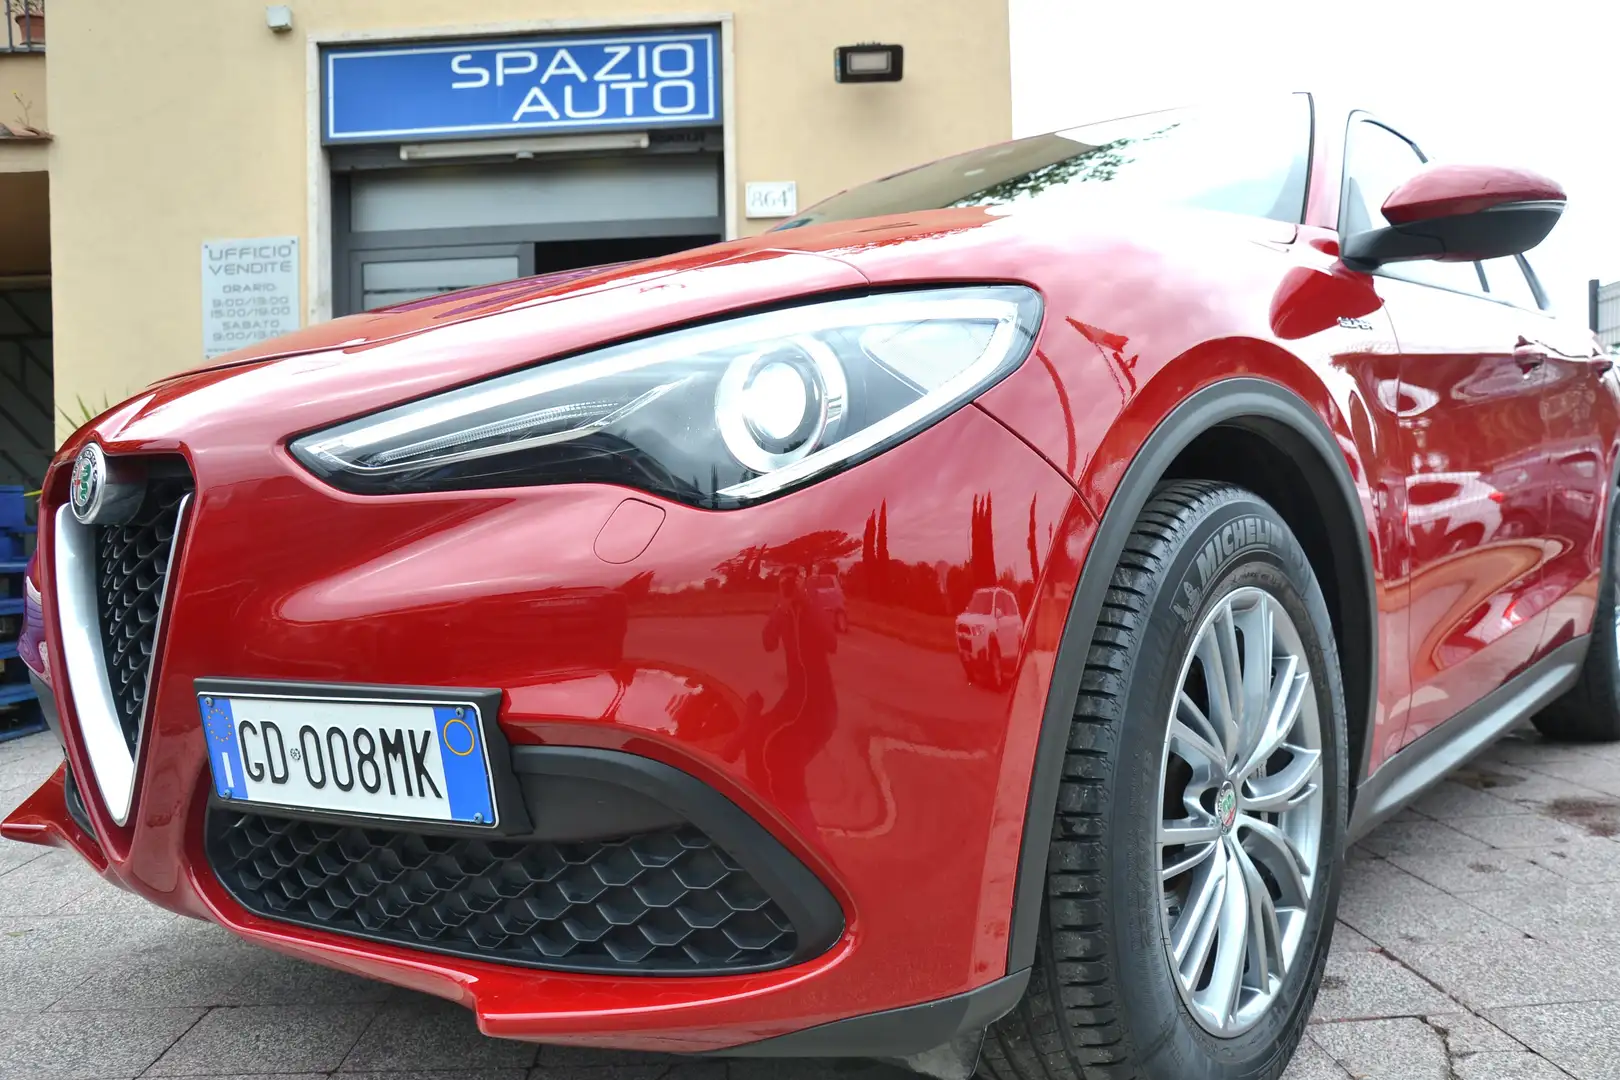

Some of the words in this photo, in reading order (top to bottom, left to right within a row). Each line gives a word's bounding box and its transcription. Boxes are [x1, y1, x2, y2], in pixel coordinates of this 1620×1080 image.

[450, 43, 695, 89] SPAZIO
[512, 78, 696, 122] AUTO
[208, 245, 291, 261] UFFICIO
[208, 260, 292, 275] VENDITE
[221, 319, 280, 331] SABATO
[1196, 518, 1283, 589] MICHELIN
